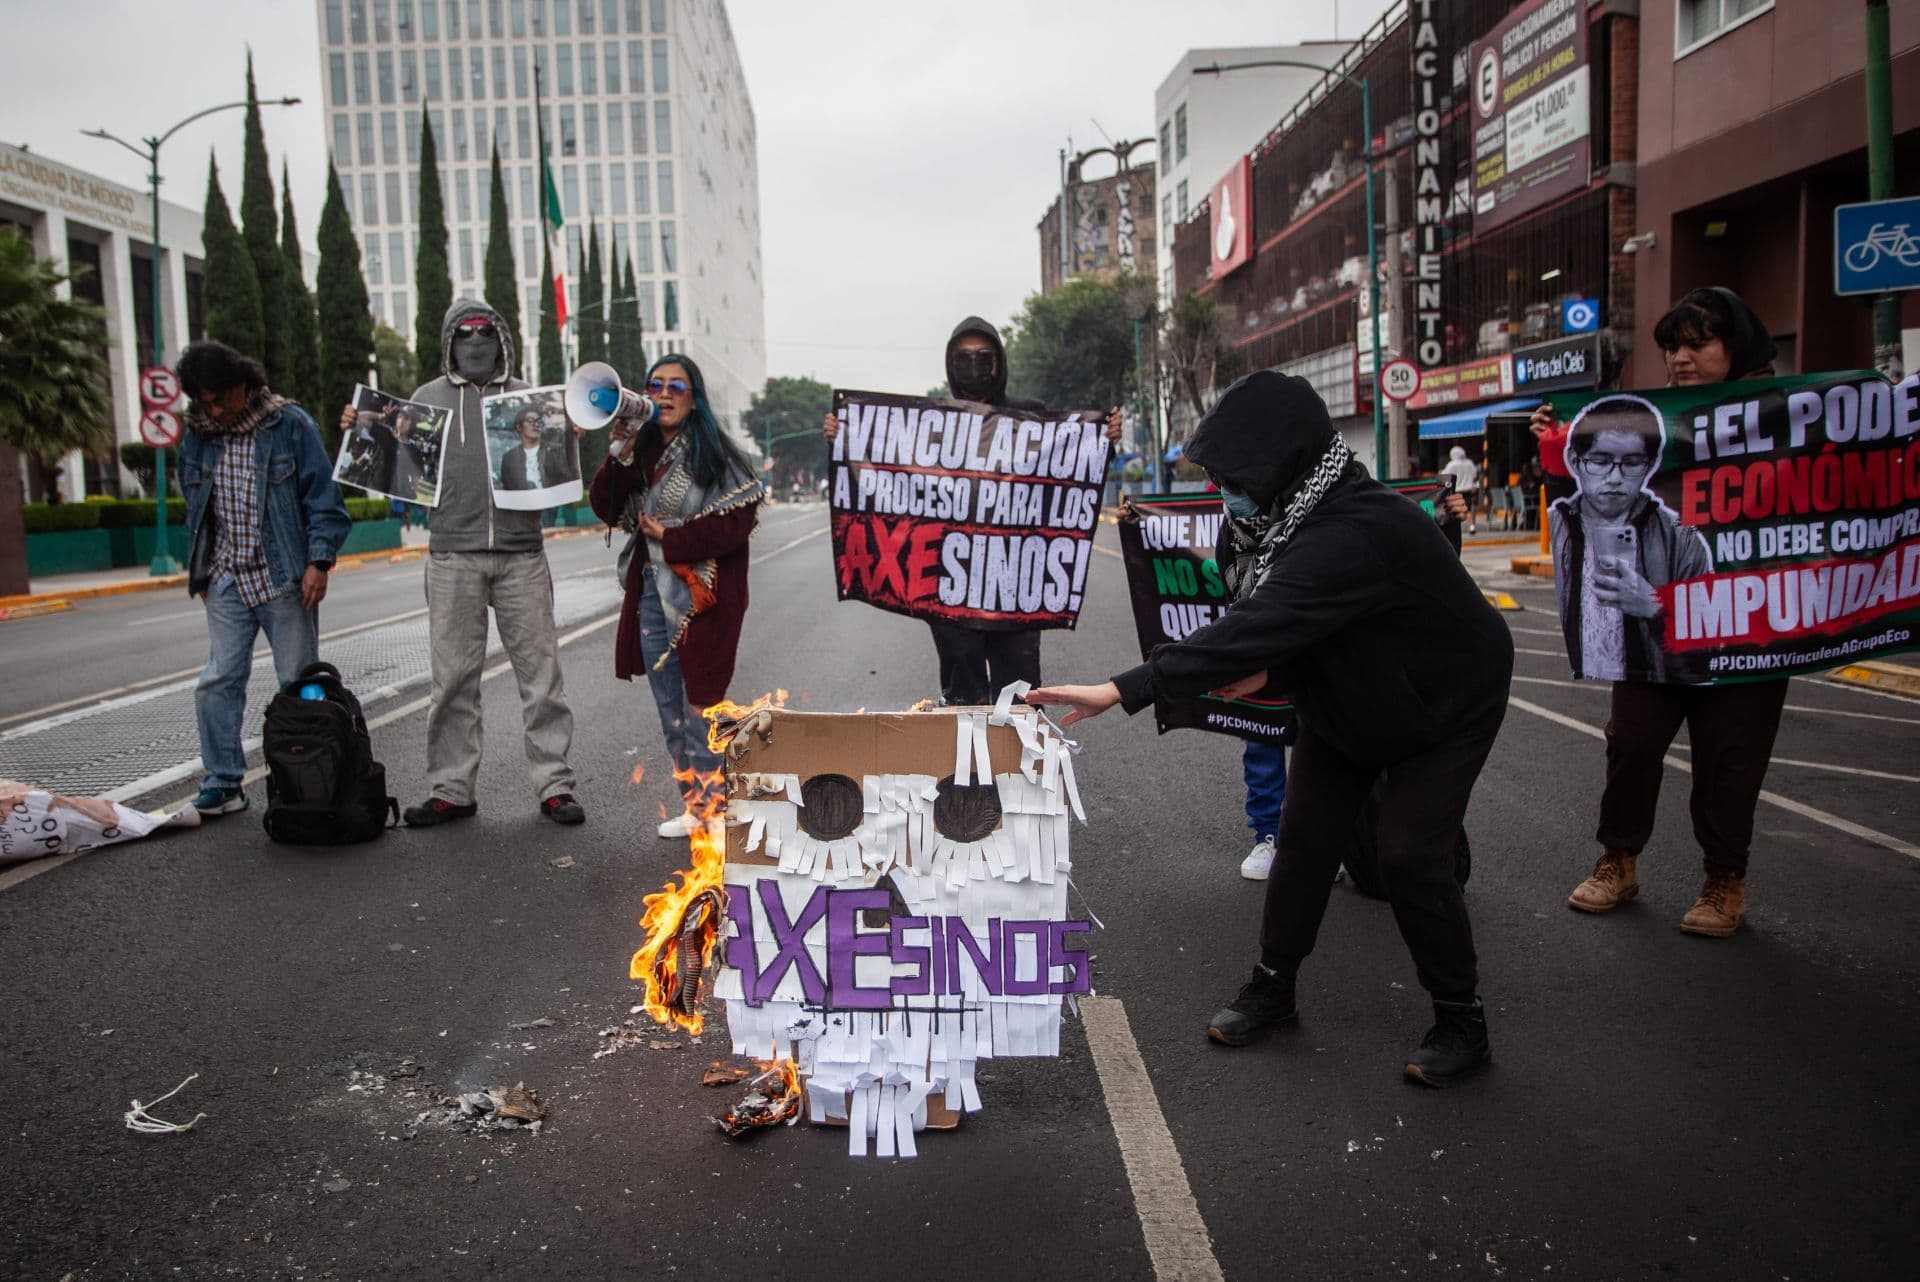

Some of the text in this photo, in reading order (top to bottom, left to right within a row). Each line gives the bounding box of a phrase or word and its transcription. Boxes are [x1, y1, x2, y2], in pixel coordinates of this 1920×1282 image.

[17, 158, 67, 193] CIUDAD
[70, 174, 87, 198] DE
[1391, 369, 1409, 384] 50
[1527, 358, 1549, 380] Punta
[1550, 352, 1562, 377] del
[832, 403, 1108, 484] ¡VINCULACIÓN
[1694, 400, 1774, 462] ¡EL
[834, 466, 1098, 530] A PROCESO PARA LOS
[1139, 515, 1191, 551] ¡QUE
[1716, 507, 1920, 563] NO DEBE COMPR
[838, 517, 1091, 613] AXESINOS!
[1152, 557, 1198, 597] NO
[1160, 602, 1211, 641] QUE
[1709, 628, 1910, 672] #PJCDMXVinculenAGrupoEco
[725, 878, 1092, 1008] AXESINOS
